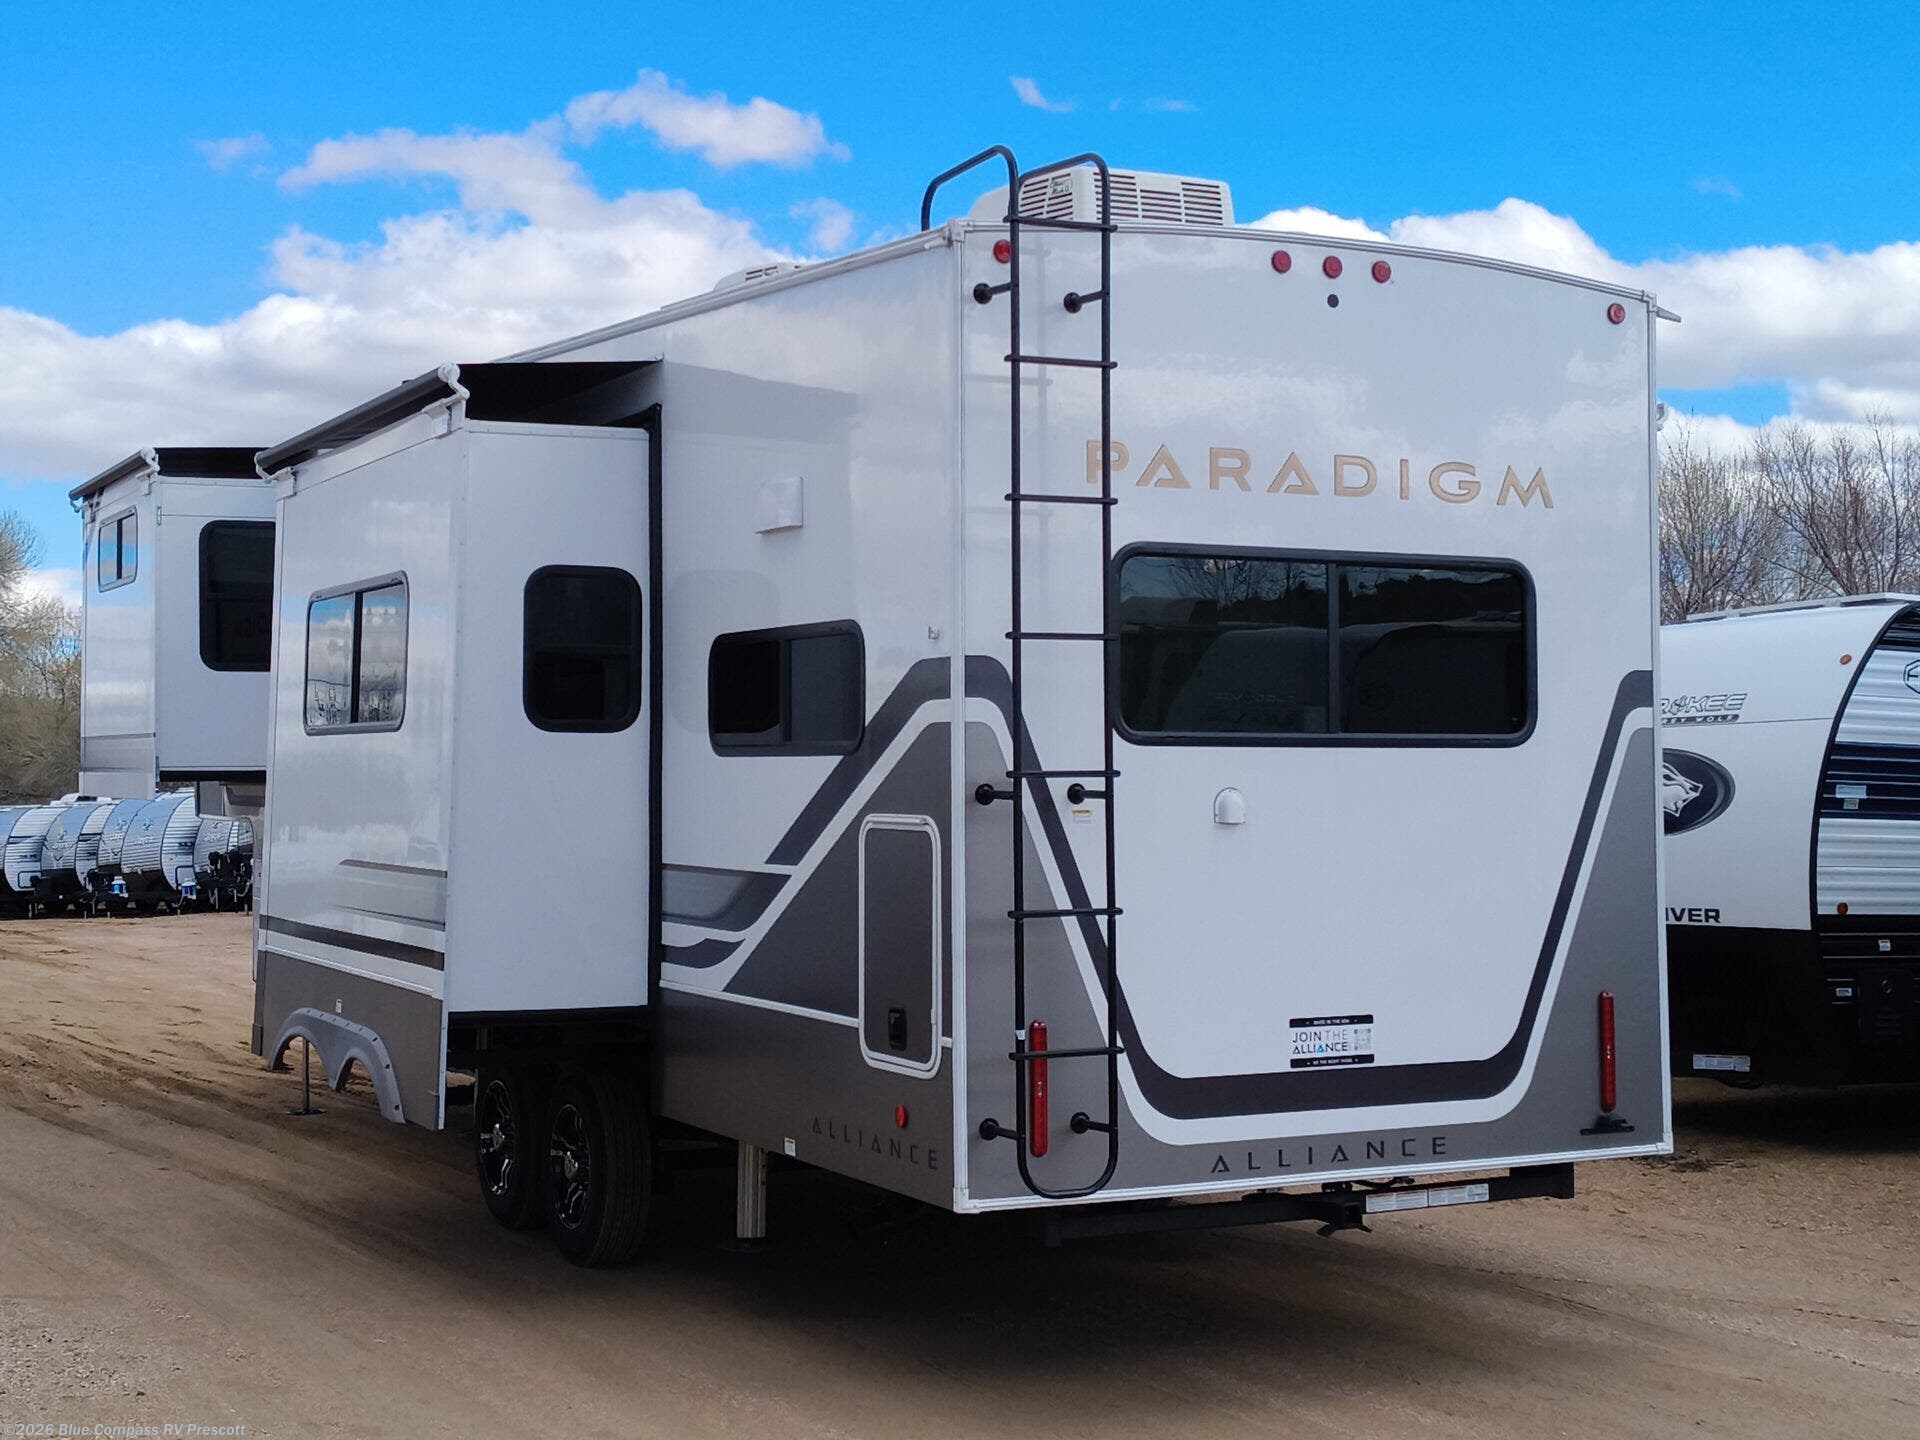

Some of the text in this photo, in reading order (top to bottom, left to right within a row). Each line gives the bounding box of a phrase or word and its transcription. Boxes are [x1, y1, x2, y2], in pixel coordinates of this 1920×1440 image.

[1086, 439, 1554, 509] PARADIGM
[1292, 1029, 1348, 1043] JOIN THE
[1292, 1042, 1348, 1054] ALLIANCE
[812, 1116, 938, 1170] ALLIANCE
[1211, 1136, 1447, 1174] ALLIANCE
